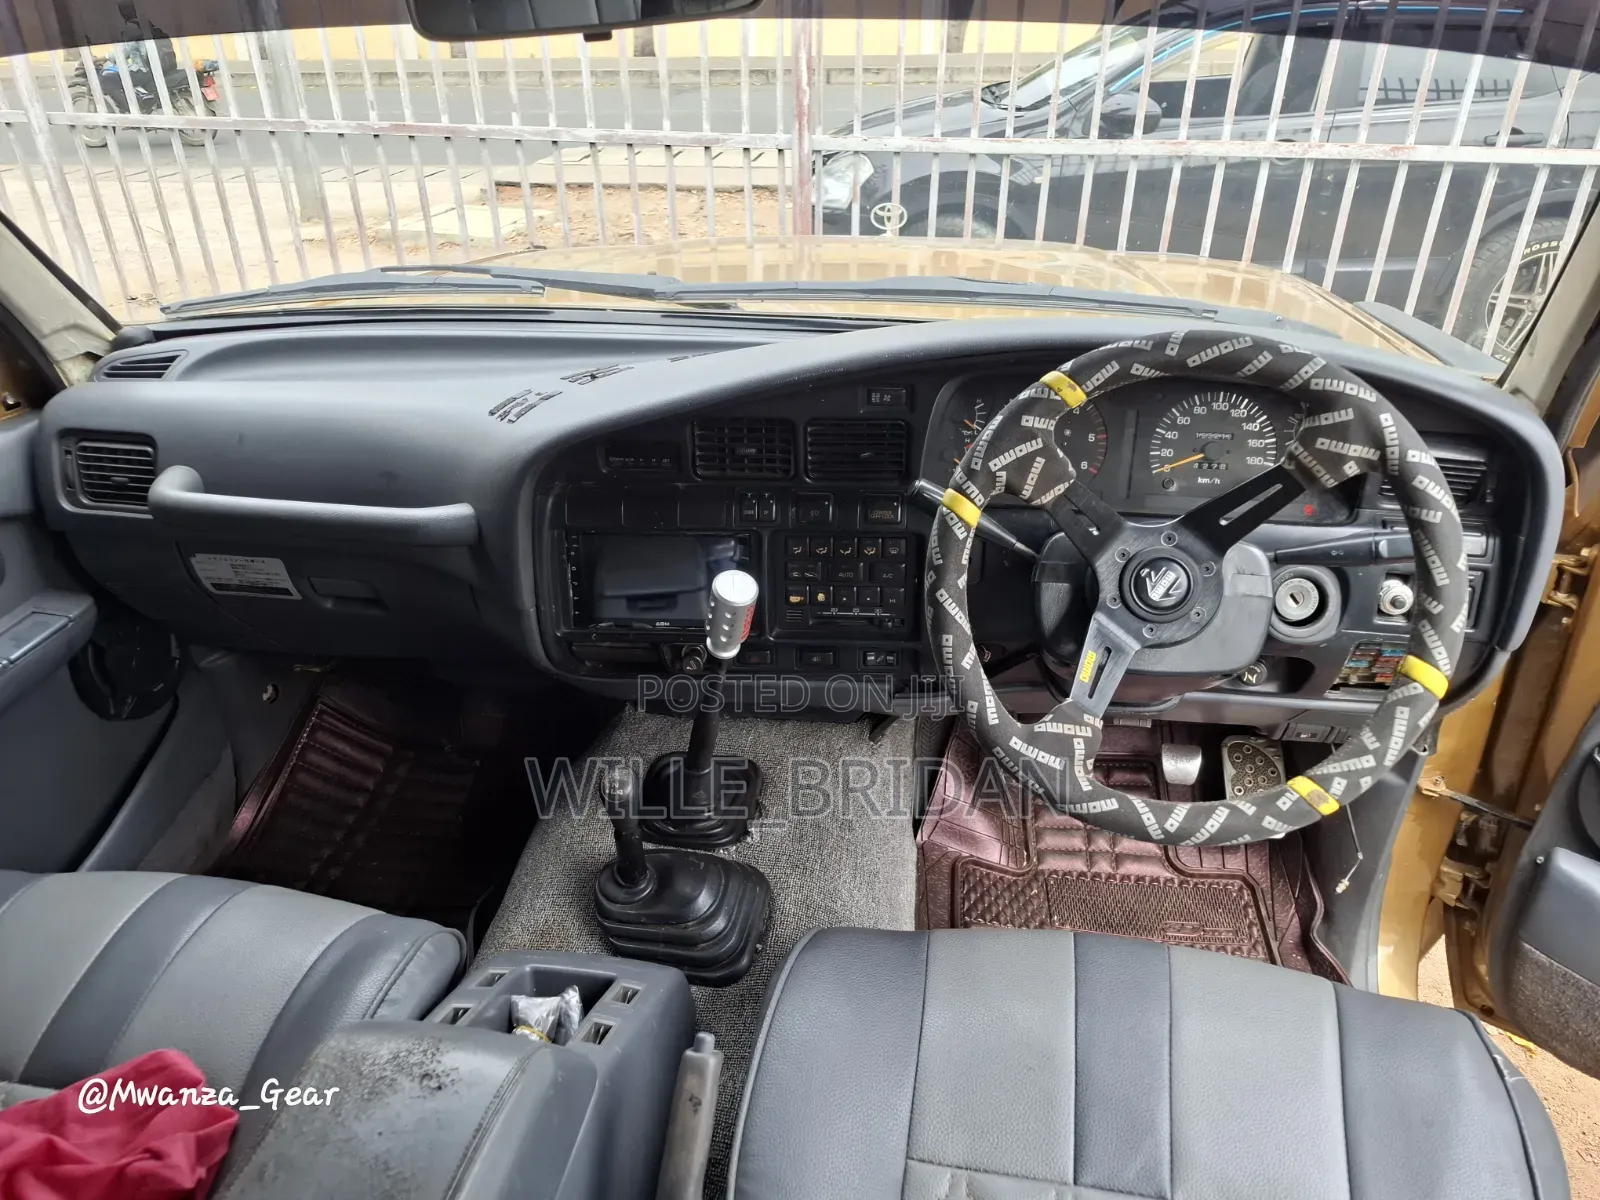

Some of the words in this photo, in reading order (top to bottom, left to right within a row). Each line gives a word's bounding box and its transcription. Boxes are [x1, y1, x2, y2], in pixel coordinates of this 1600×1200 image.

[1186, 337, 1253, 367] momo
[1310, 378, 1377, 402] momo
[1194, 406, 1207, 415] 80
[1211, 402, 1229, 411] 100
[1230, 409, 1247, 418] 120
[1177, 416, 1190, 425] 60
[1242, 422, 1260, 431] 140
[1088, 434, 1095, 442] 5
[1164, 431, 1178, 440] 40
[1247, 439, 1265, 448] 160
[1379, 412, 1399, 476] momo
[1160, 449, 1174, 457] 20
[1315, 438, 1381, 460] momo
[988, 438, 1043, 472] momo
[1246, 456, 1264, 465] 180
[1081, 462, 1088, 470] 6
[1198, 477, 1220, 485] km/h
[1150, 570, 1176, 601] momo
[1034, 722, 1092, 737] momo
[1383, 706, 1410, 766] momo
[1009, 736, 1065, 770] momo
[1073, 738, 1092, 791] momo
